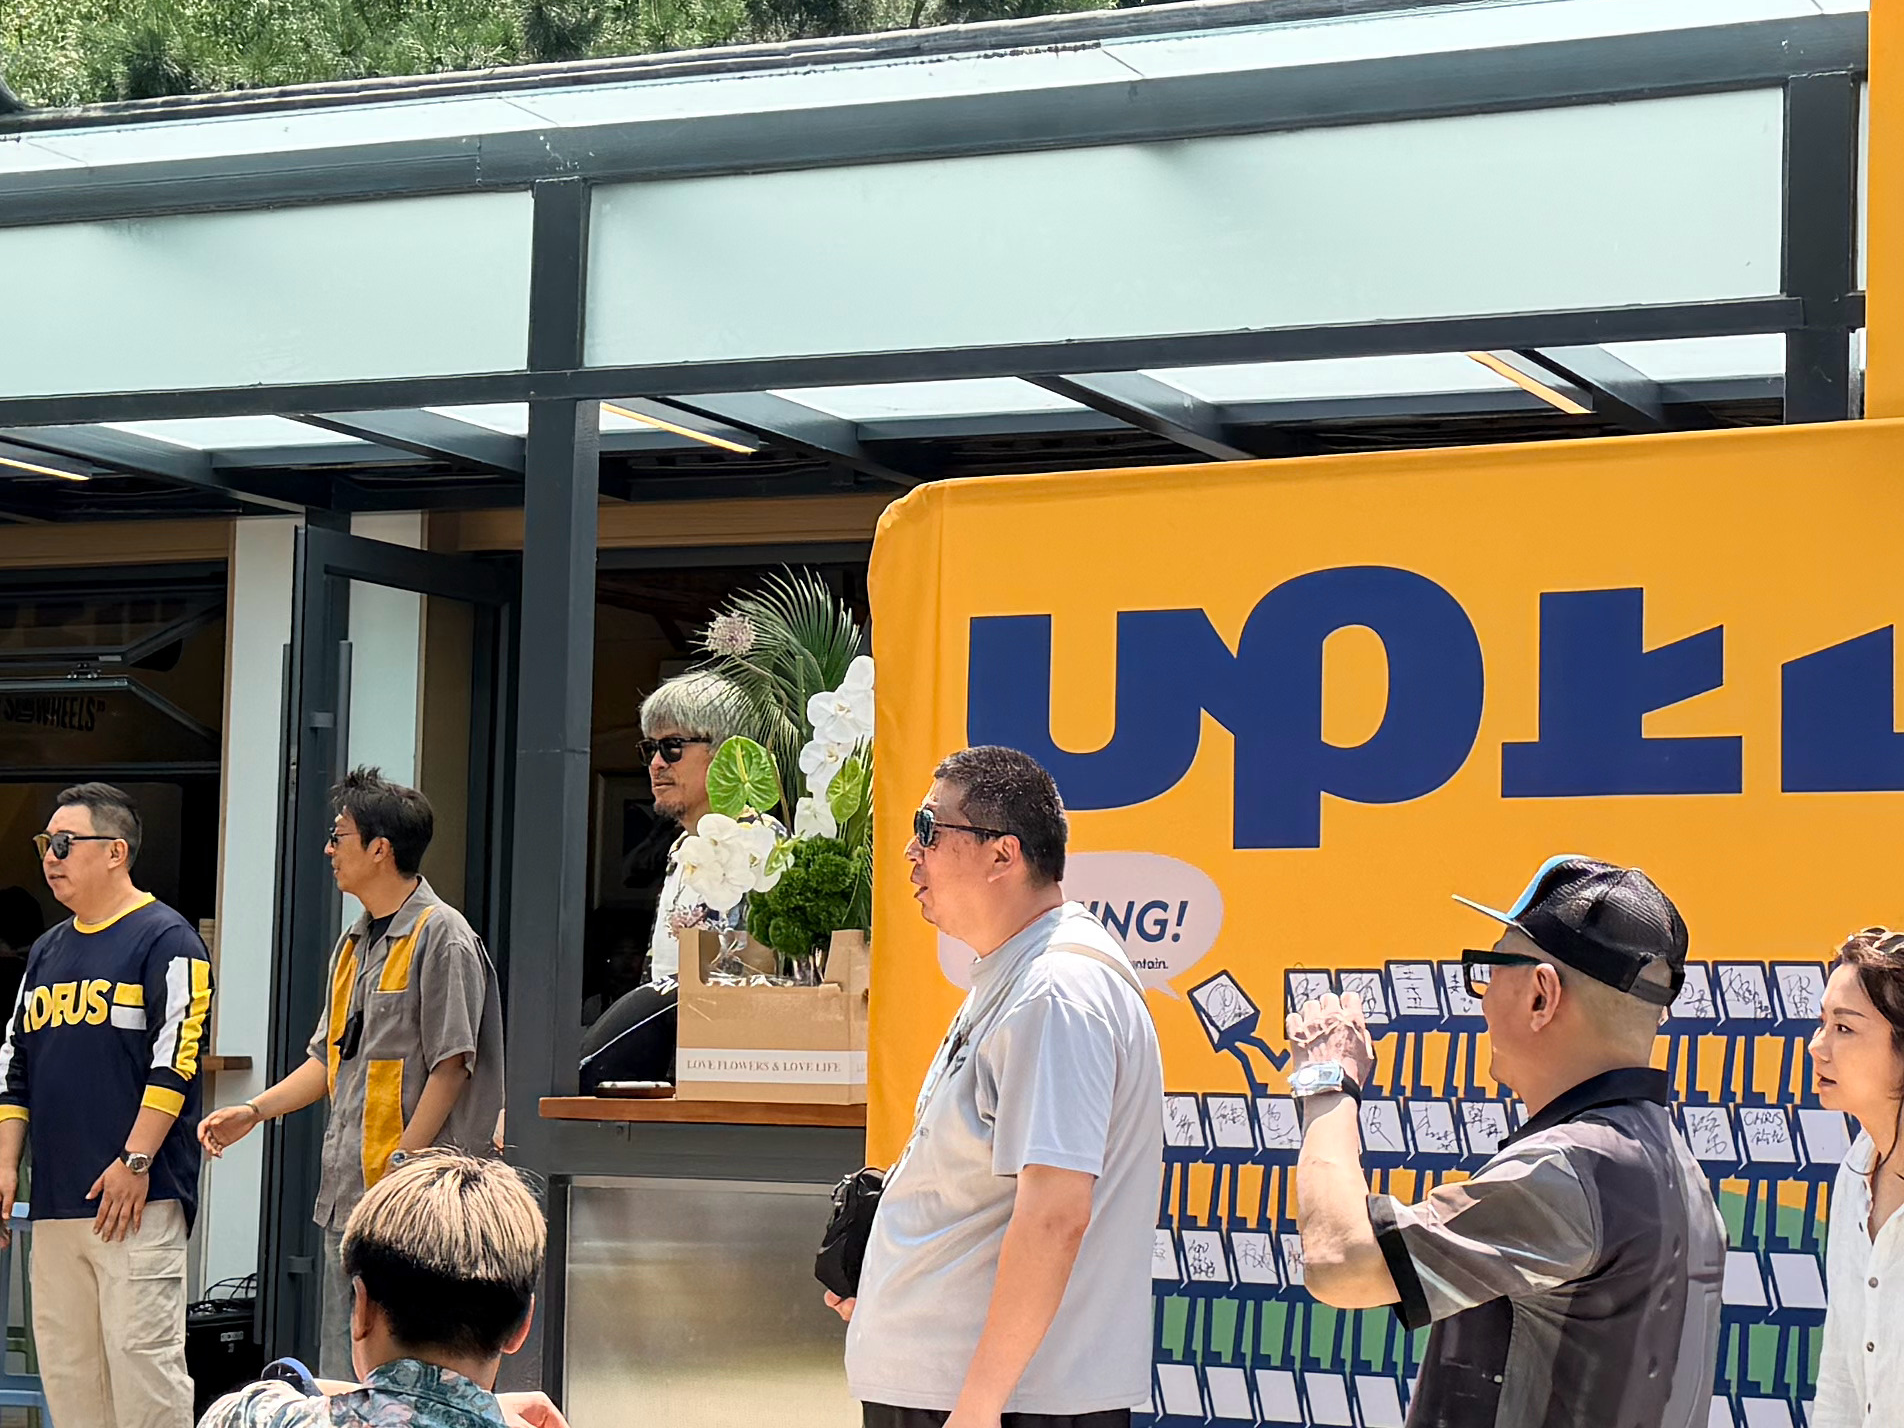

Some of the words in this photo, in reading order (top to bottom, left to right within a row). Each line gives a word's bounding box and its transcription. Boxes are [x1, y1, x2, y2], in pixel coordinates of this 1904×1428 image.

[687, 1059, 715, 1070] LOVE
[771, 1062, 780, 1072] &
[782, 1061, 814, 1072] LOVE
